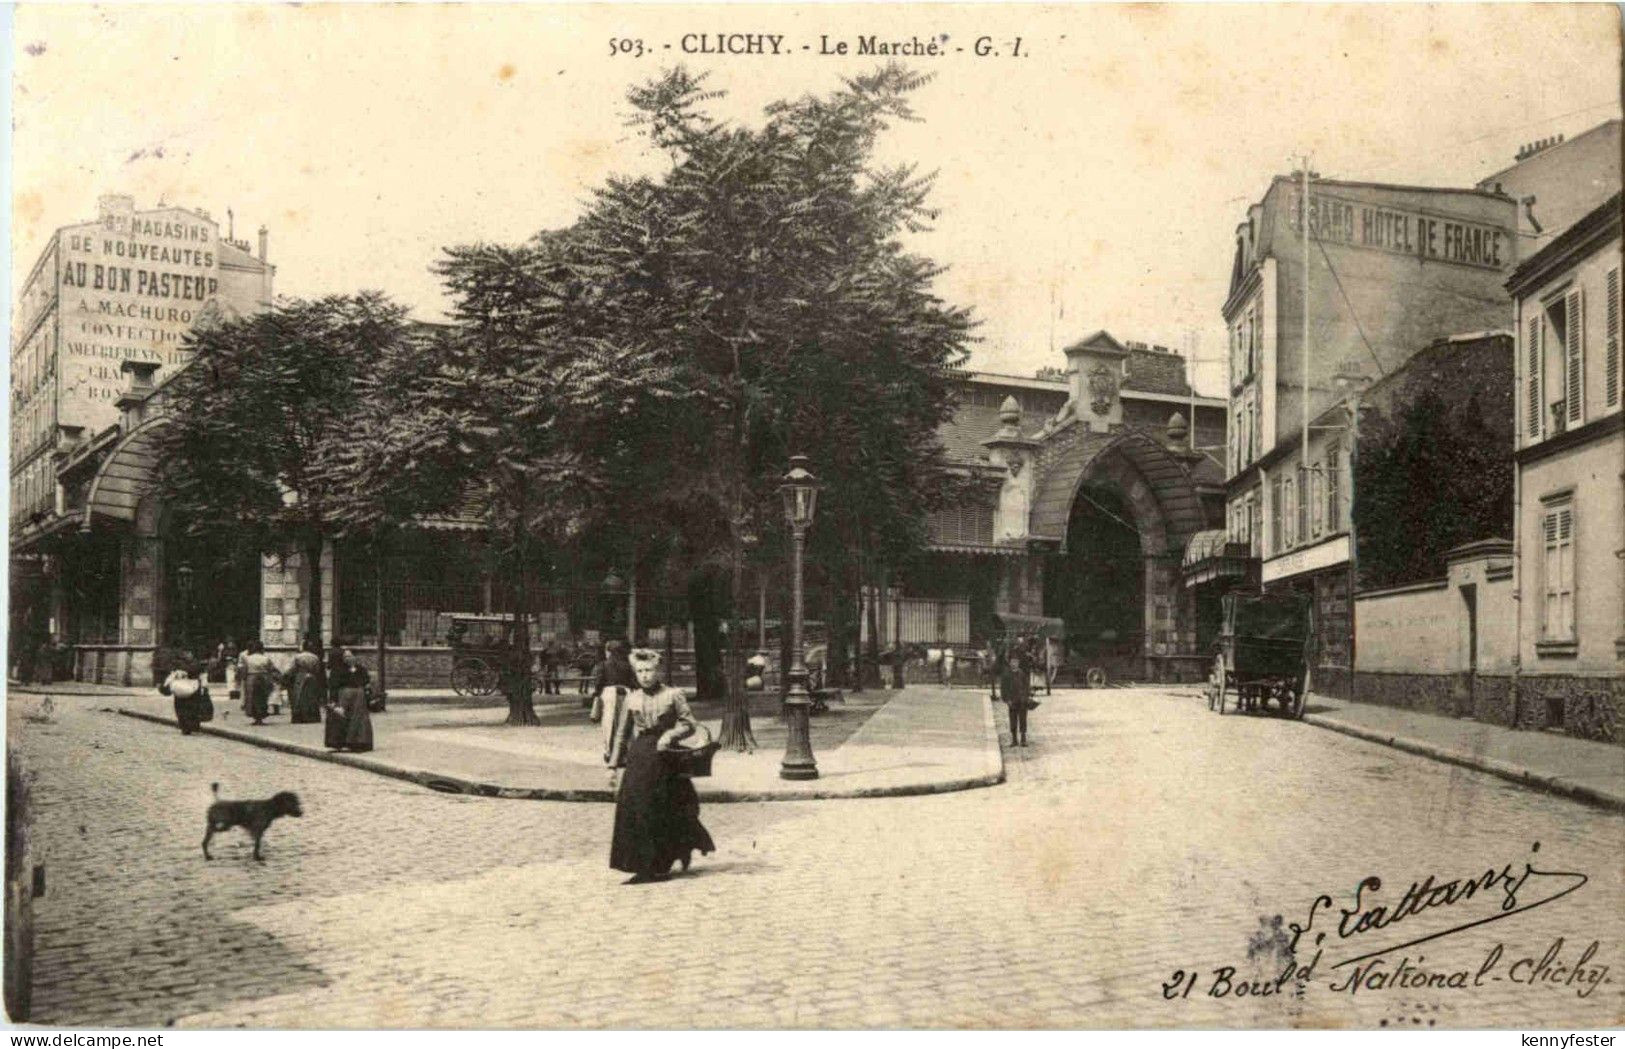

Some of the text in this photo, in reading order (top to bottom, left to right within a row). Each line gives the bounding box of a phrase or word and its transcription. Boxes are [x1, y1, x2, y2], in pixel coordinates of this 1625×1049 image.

[132, 217, 209, 242] MAGASINS
[1296, 195, 1501, 267] RAND HOTEL DE FRANCE
[71, 235, 92, 253] DE
[63, 261, 219, 301] AU BON PASTEUR
[99, 300, 199, 324] MACHURO
[1162, 969, 1198, 1000] 21
